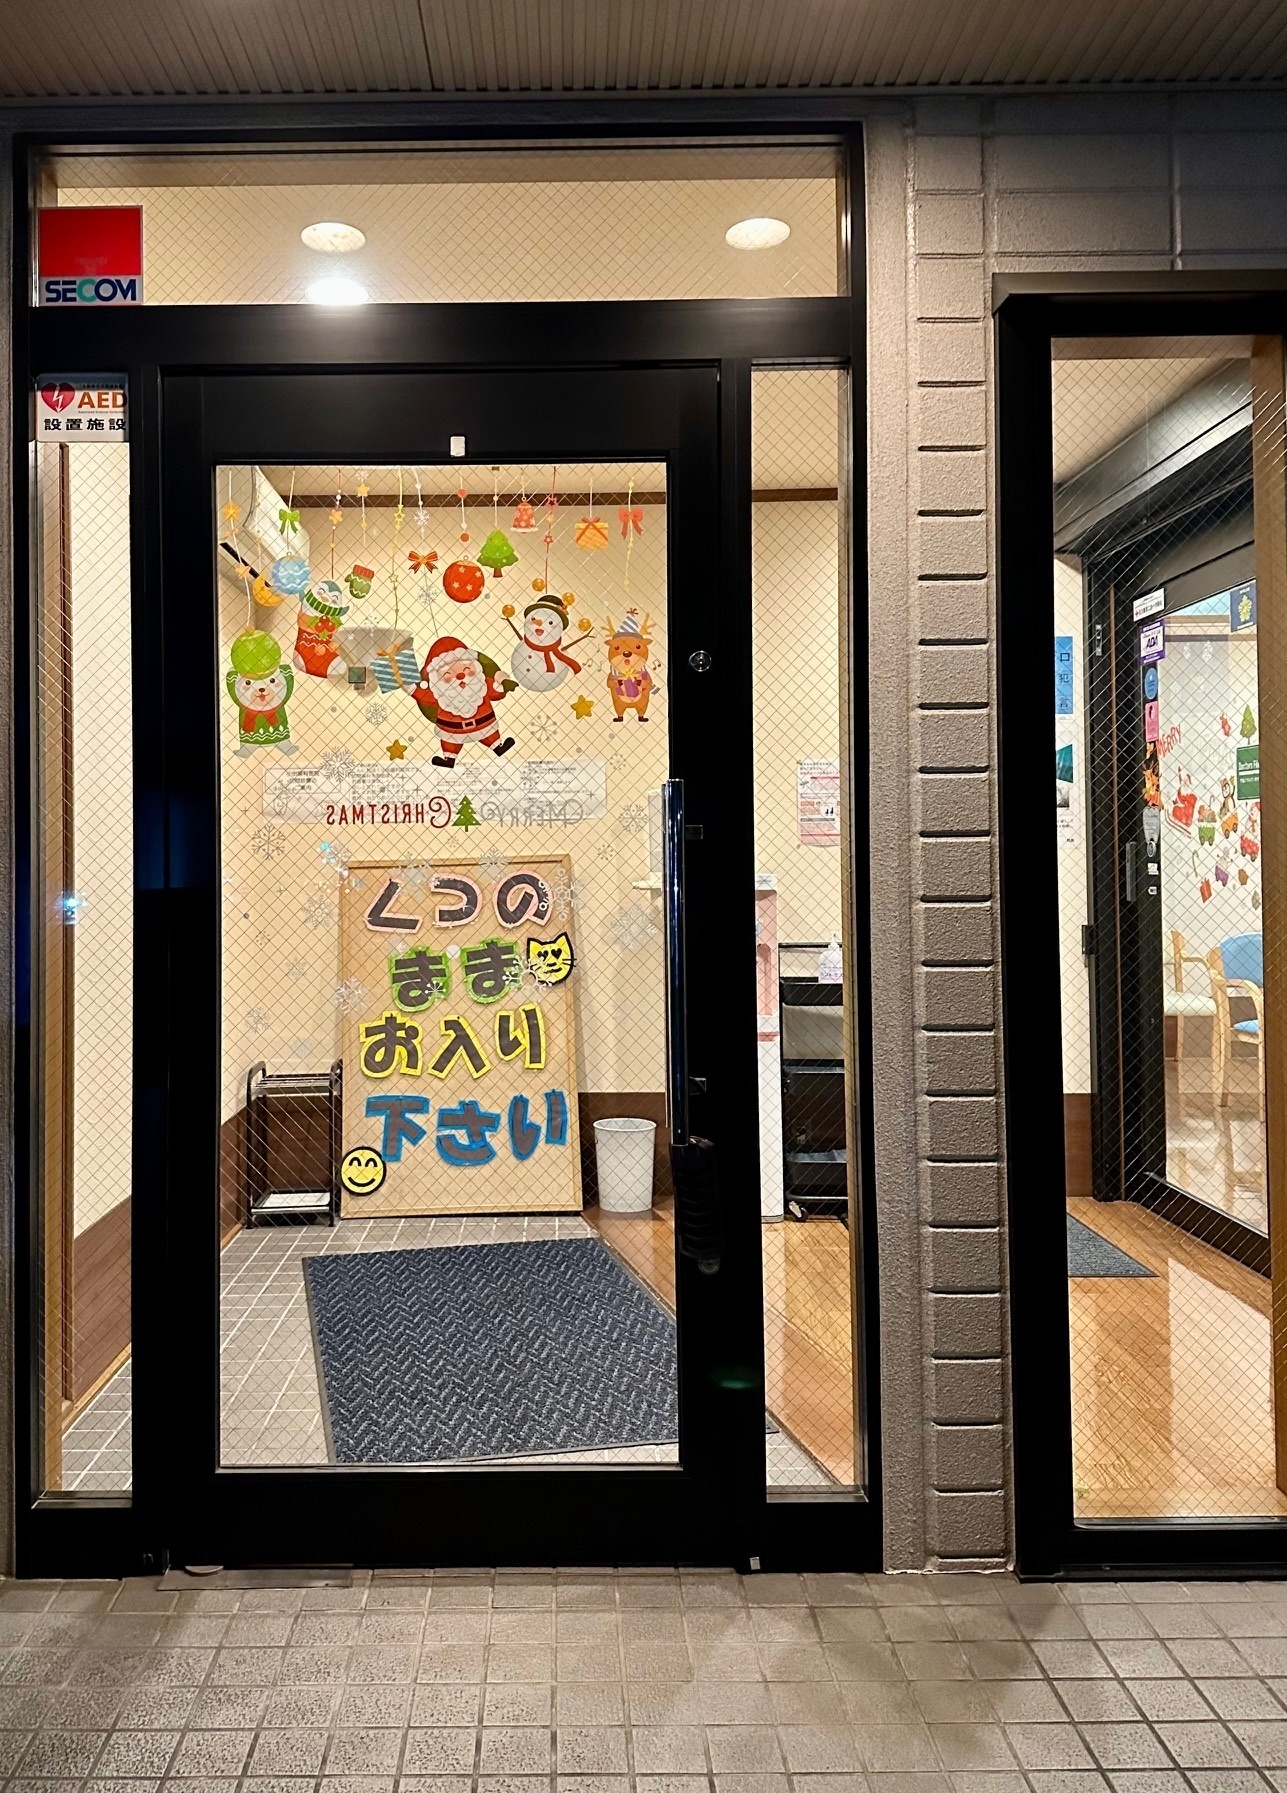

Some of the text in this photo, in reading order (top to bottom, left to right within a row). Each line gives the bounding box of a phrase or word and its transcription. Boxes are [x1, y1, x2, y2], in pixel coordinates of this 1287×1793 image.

[45, 278, 137, 303] SECOM
[44, 418, 126, 431] 設置施設
[77, 391, 128, 409] AED
[364, 869, 555, 934] くつの
[388, 936, 524, 1013] まま
[359, 1003, 547, 1080] お入り
[365, 1089, 567, 1167] 下さい
